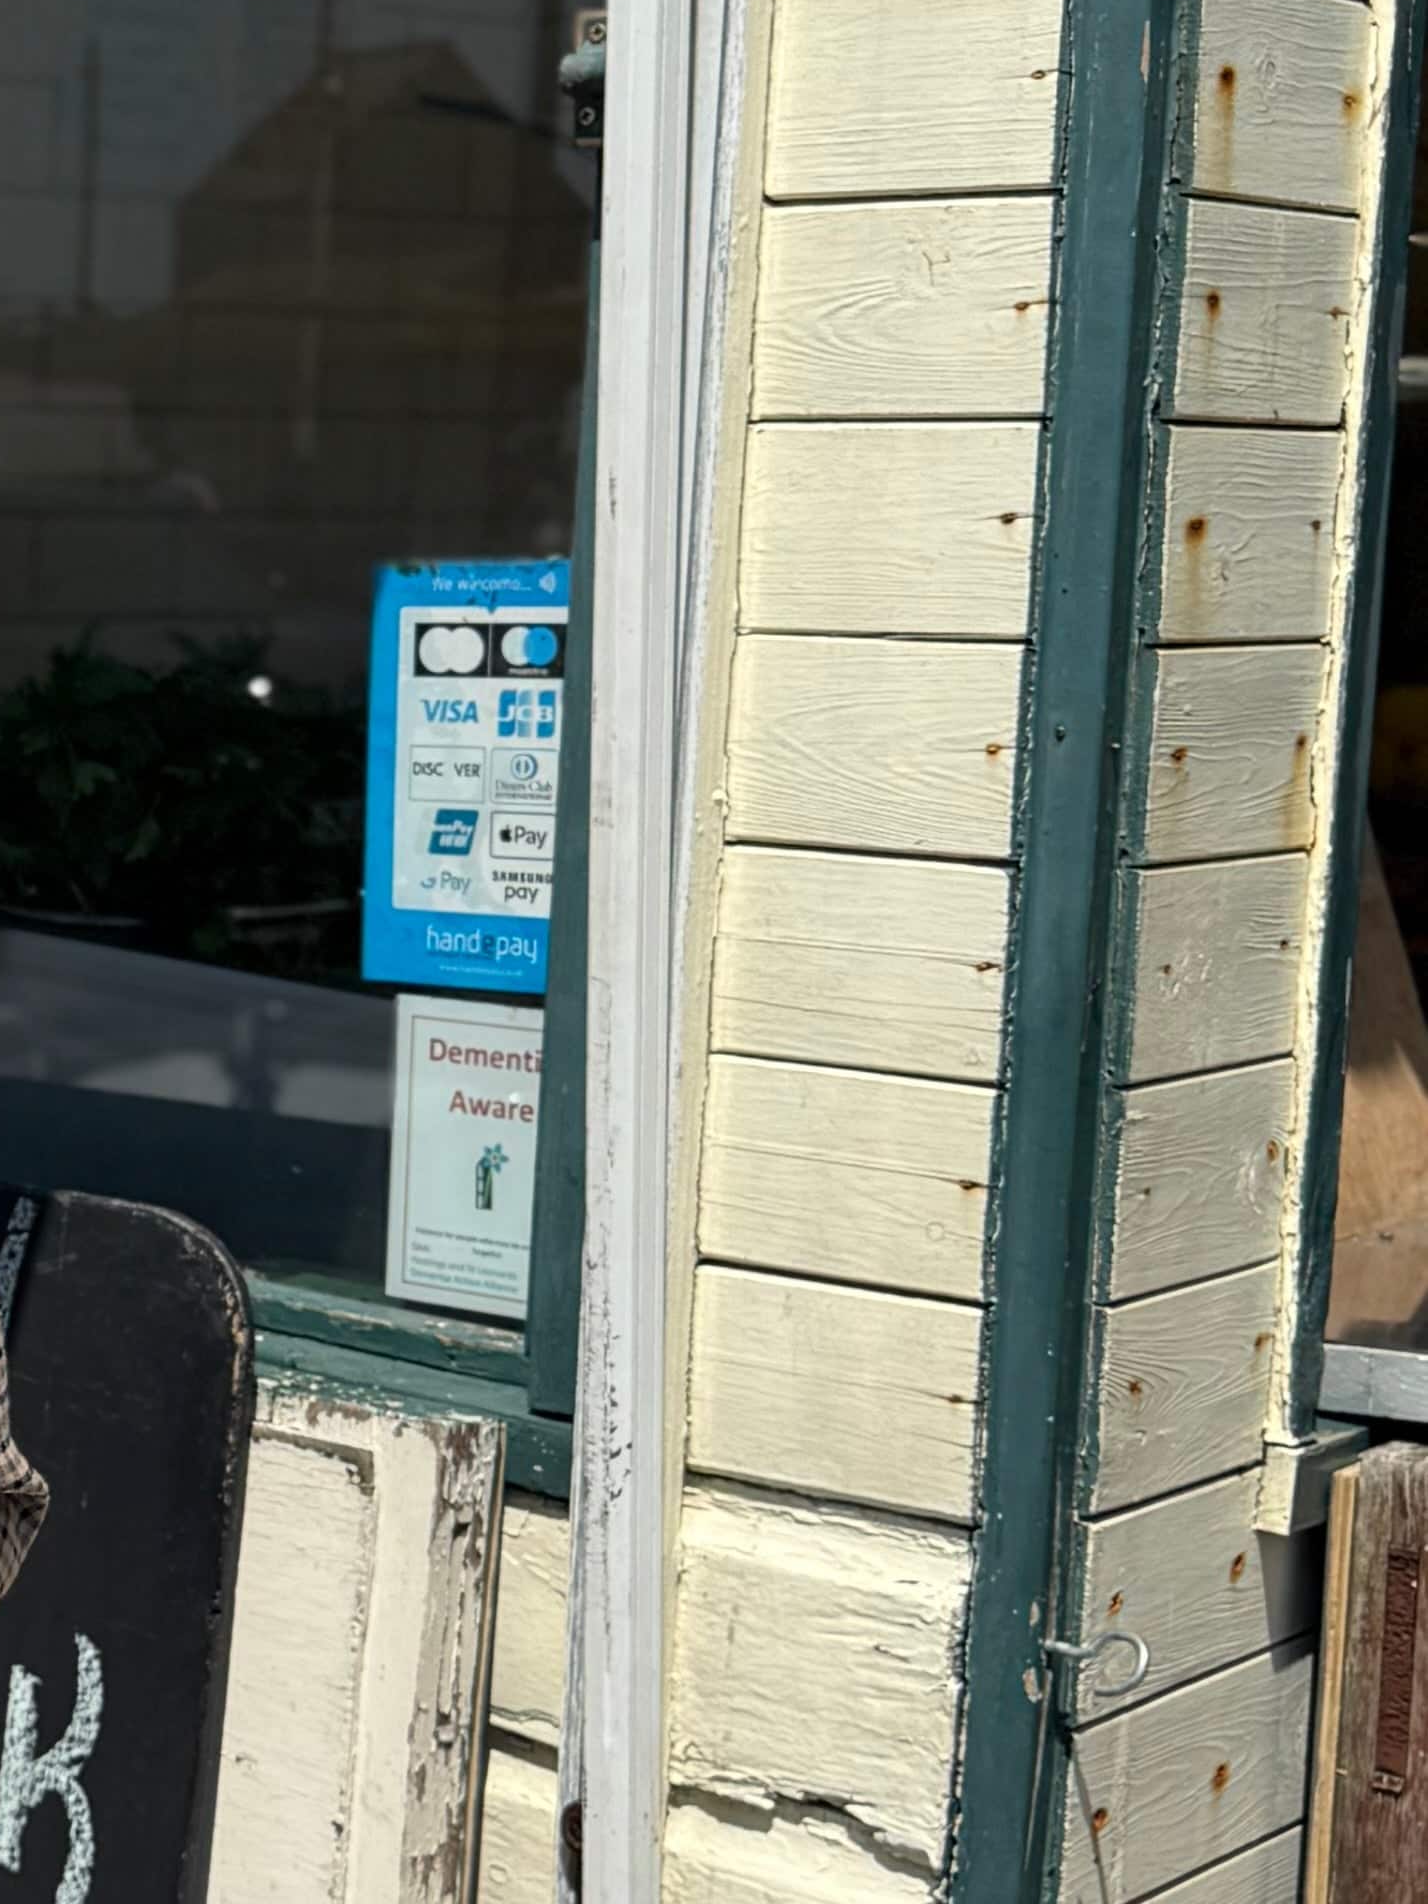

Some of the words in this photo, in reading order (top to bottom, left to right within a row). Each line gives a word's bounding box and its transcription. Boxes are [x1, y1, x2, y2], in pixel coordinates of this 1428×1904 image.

[420, 699, 479, 724] VISA
[411, 760, 482, 780] DISCVER
[513, 825, 547, 850] Pay
[503, 886, 539, 905] pay
[447, 1089, 536, 1124] Aware
